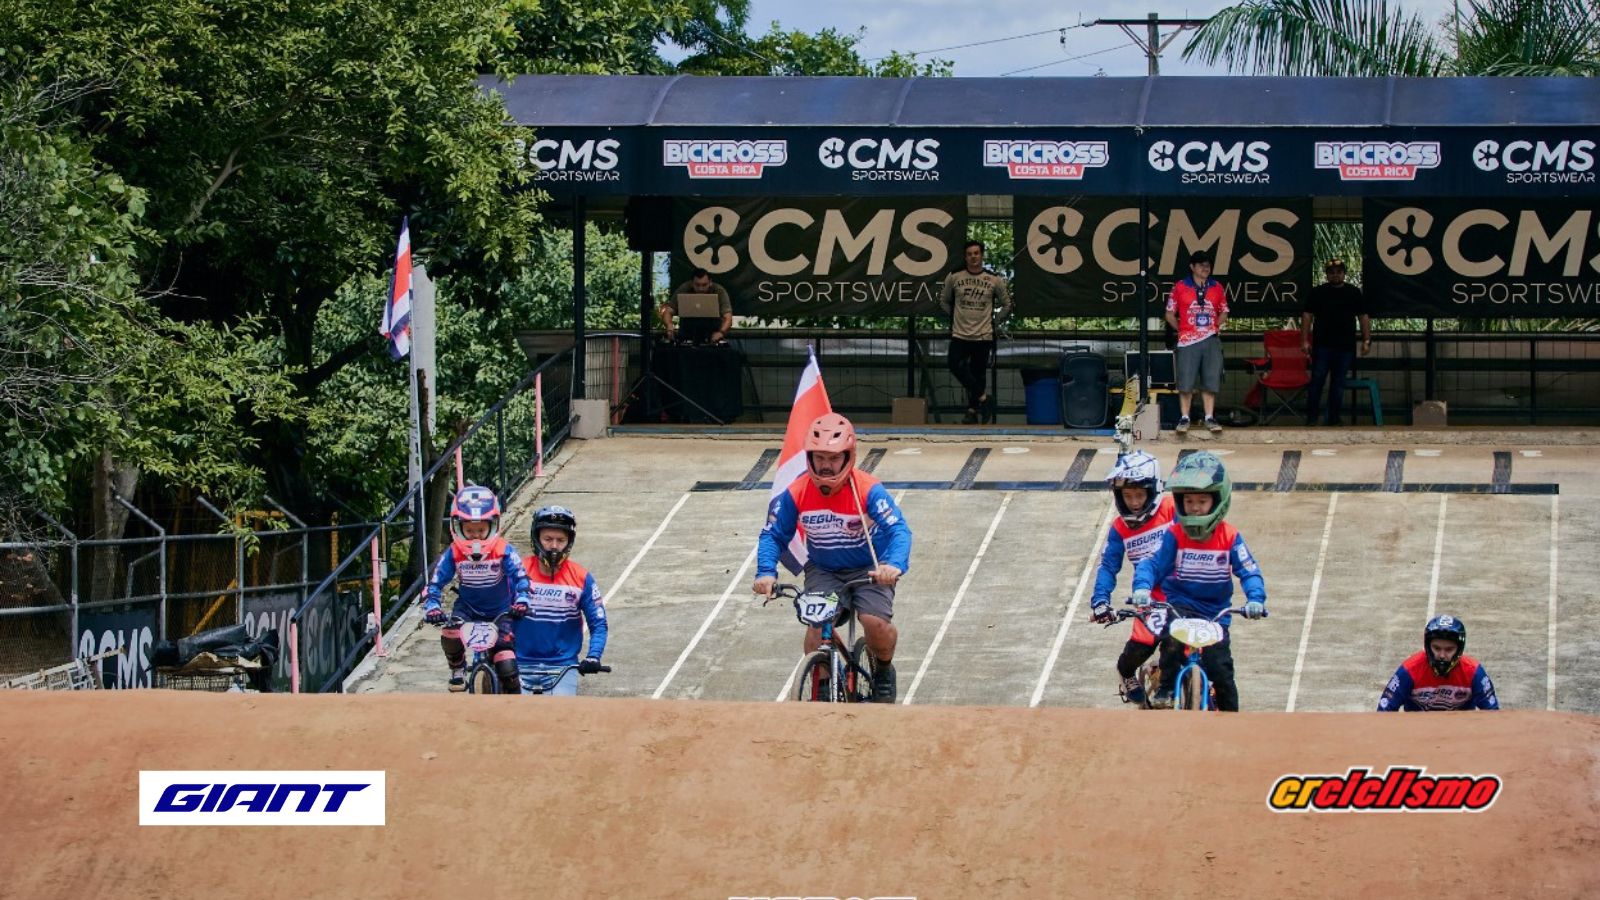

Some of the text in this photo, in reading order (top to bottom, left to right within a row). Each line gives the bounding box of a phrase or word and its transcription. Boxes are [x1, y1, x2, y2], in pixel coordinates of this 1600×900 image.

[529, 139, 621, 170] CMS
[667, 142, 786, 164] BICICROSS
[847, 138, 940, 169] CMS
[986, 142, 1108, 165] BICICROSS
[1176, 140, 1271, 172] CMS
[1317, 143, 1439, 166] BICICROSS
[1502, 140, 1597, 171] CMS
[534, 170, 620, 181] SPORTSWEAR
[694, 164, 757, 175] COSTA RICA
[852, 170, 940, 181] SPORTSWEAR
[1014, 165, 1078, 176] COSTA RICA
[1181, 173, 1270, 184] SPORTSWEAR
[1346, 166, 1410, 177] COSTA RICA
[1506, 172, 1596, 183] SPORTSWEAR
[748, 207, 954, 276] CMS
[1092, 207, 1300, 277] CMS
[806, 603, 826, 616] 07
